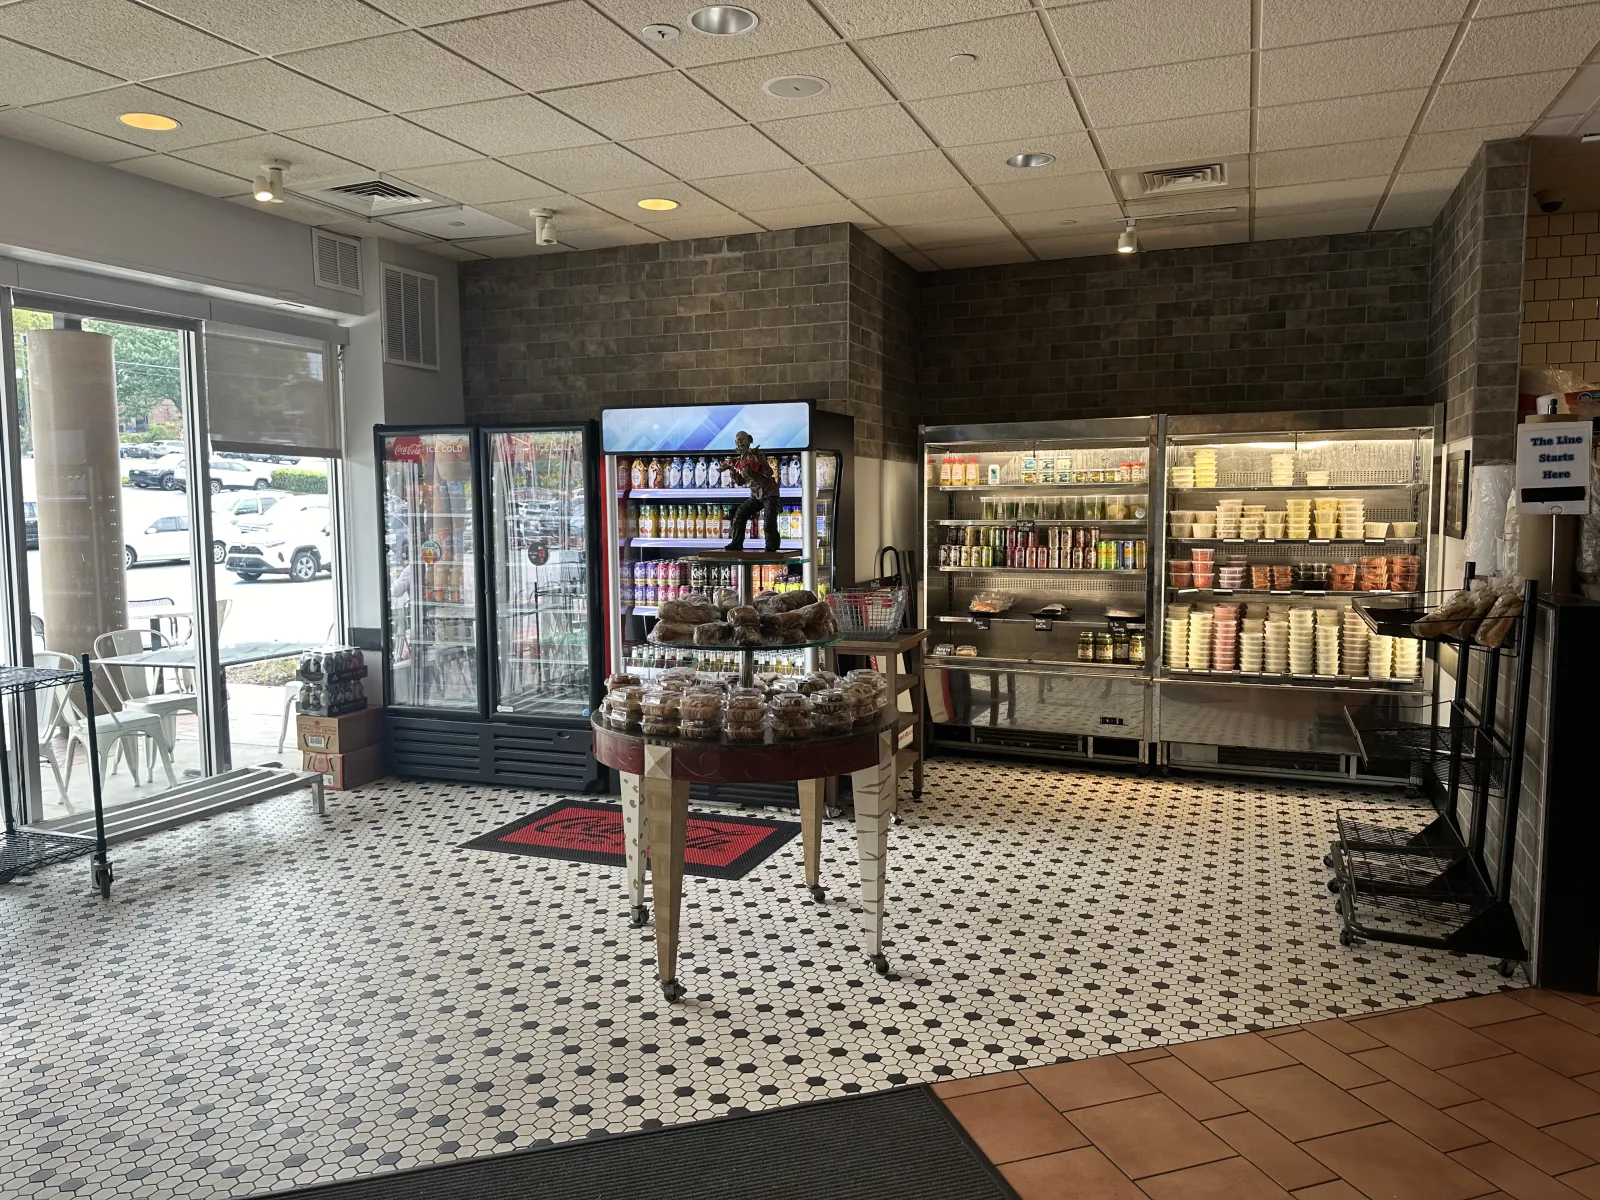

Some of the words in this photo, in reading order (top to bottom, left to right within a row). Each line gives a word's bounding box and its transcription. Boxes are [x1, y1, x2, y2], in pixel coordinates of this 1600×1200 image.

[1530, 437, 1553, 446] The
[1556, 435, 1583, 445] Line
[441, 445, 463, 453] COLD
[1538, 453, 1575, 463] Starts
[1542, 470, 1571, 480] Here
